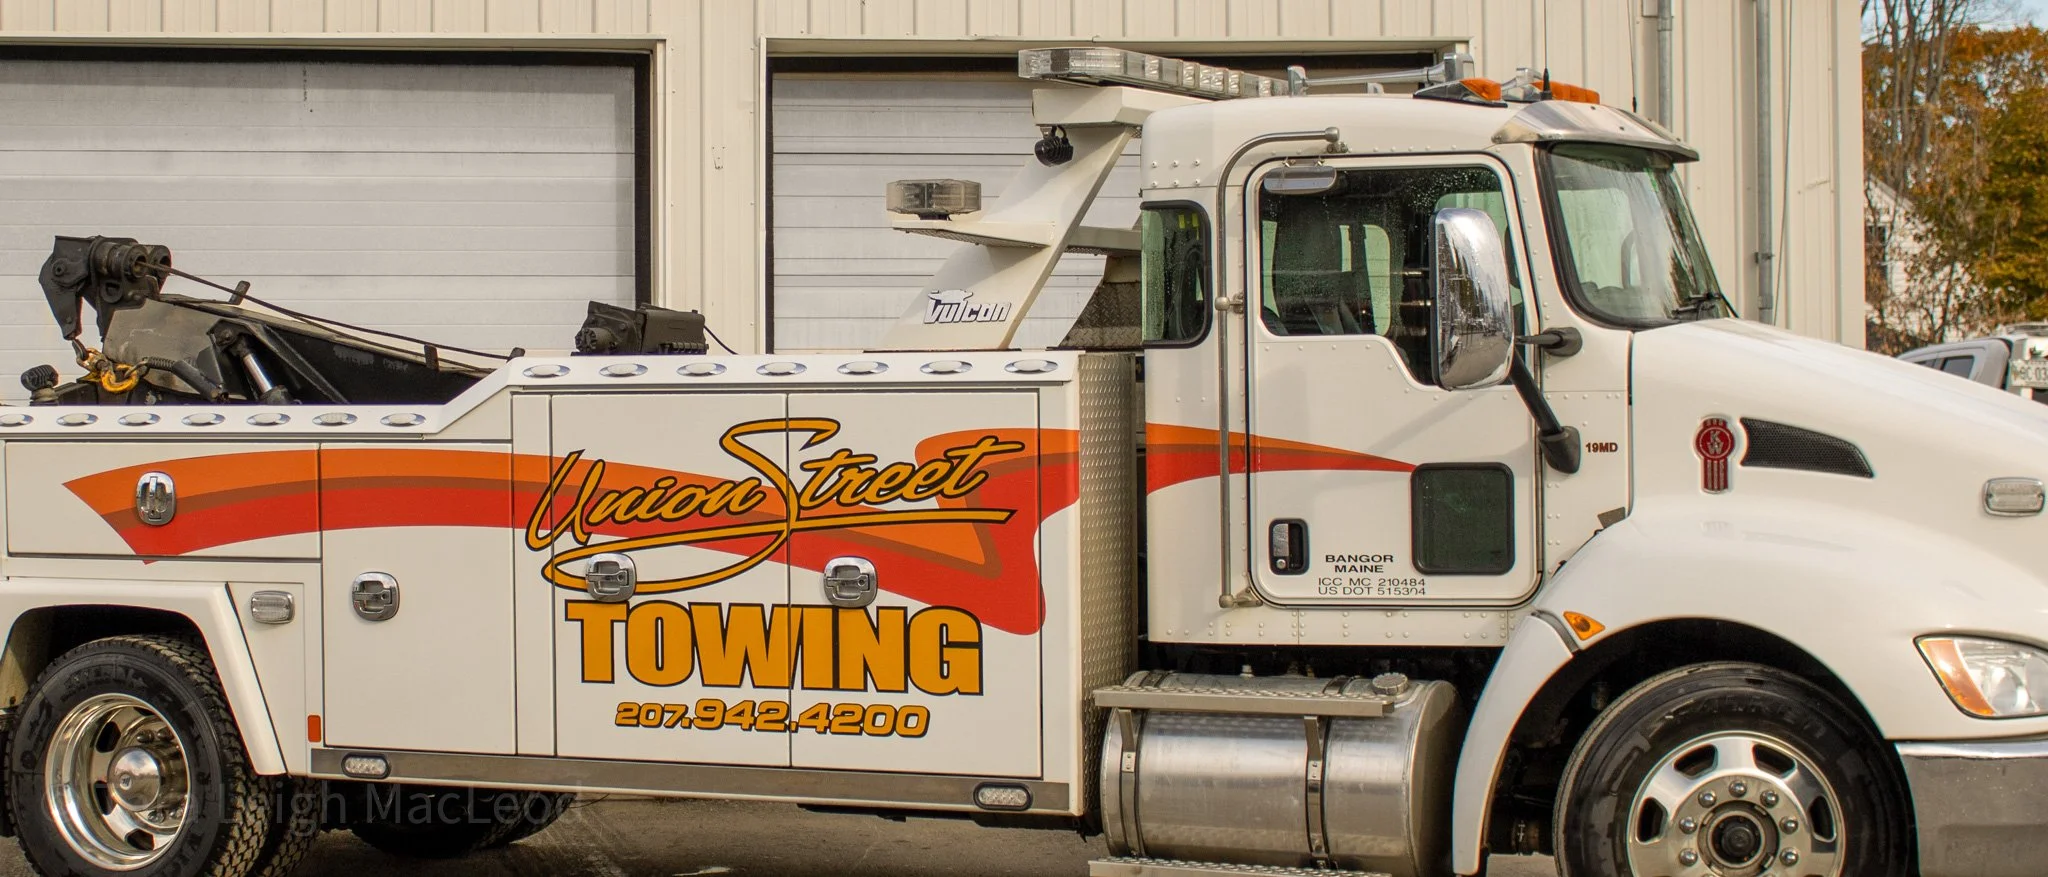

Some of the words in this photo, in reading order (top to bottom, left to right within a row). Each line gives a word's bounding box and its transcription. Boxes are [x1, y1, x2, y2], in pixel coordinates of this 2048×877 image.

[1585, 442, 1619, 453] 19MD
[524, 448, 767, 552] Union
[718, 416, 1026, 525] Street
[1325, 554, 1394, 563] BANGOR
[1334, 564, 1384, 573] MAINE
[1318, 577, 1343, 587] ICC
[1349, 577, 1371, 587] MC
[1378, 578, 1426, 587] 210484
[1318, 586, 1338, 596] US
[1343, 586, 1374, 596] DOT
[1377, 587, 1426, 596] 515304
[564, 599, 984, 697] TOWING
[614, 698, 931, 738] 207.942.4200
